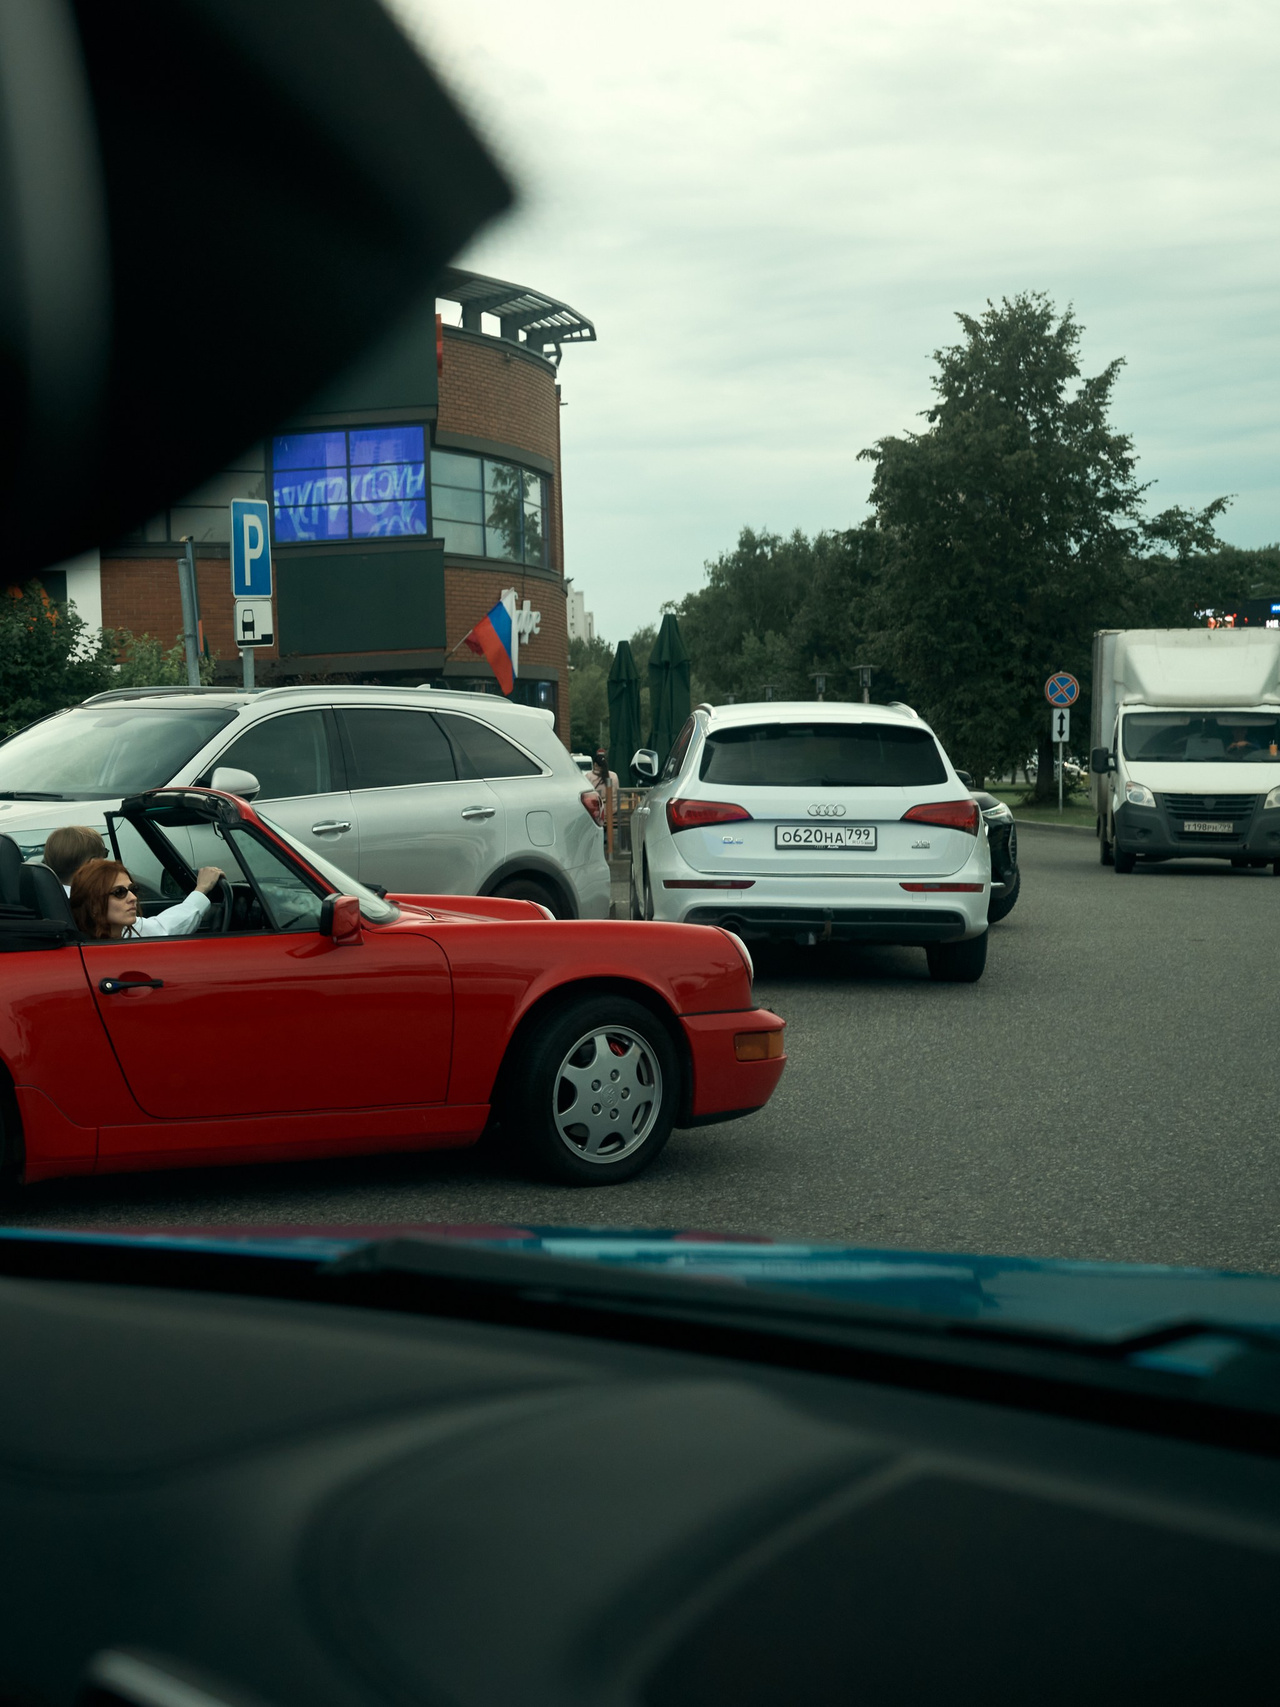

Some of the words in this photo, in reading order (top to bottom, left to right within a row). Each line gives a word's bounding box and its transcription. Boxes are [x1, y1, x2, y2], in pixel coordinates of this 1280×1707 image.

[242, 513, 264, 586] P
[782, 828, 844, 844] О620НА
[846, 828, 871, 840] 799
